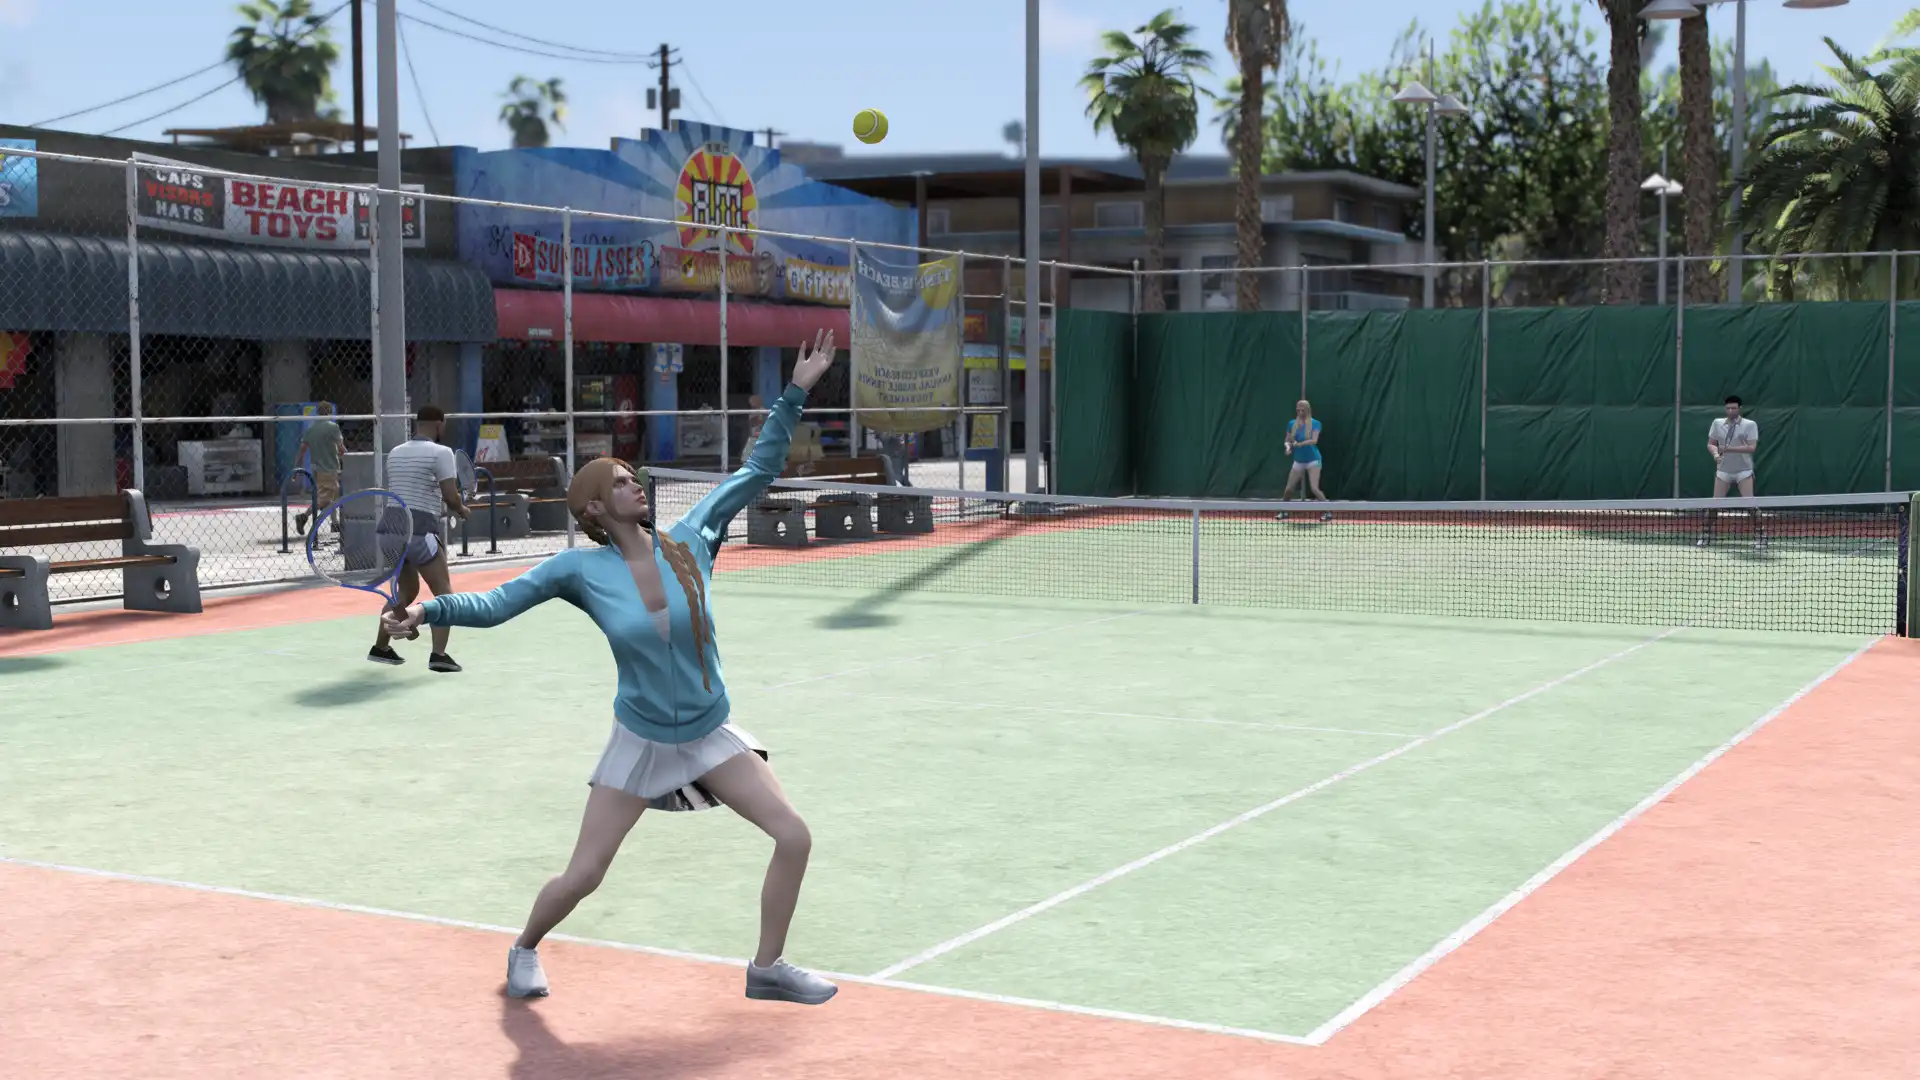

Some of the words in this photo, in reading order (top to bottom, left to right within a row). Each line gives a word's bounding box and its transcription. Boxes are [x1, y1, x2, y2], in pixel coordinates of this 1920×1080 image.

[156, 169, 204, 189] CAPS
[156, 199, 205, 223] HATS
[231, 180, 349, 215] BEACH
[245, 210, 338, 241] TOYS
